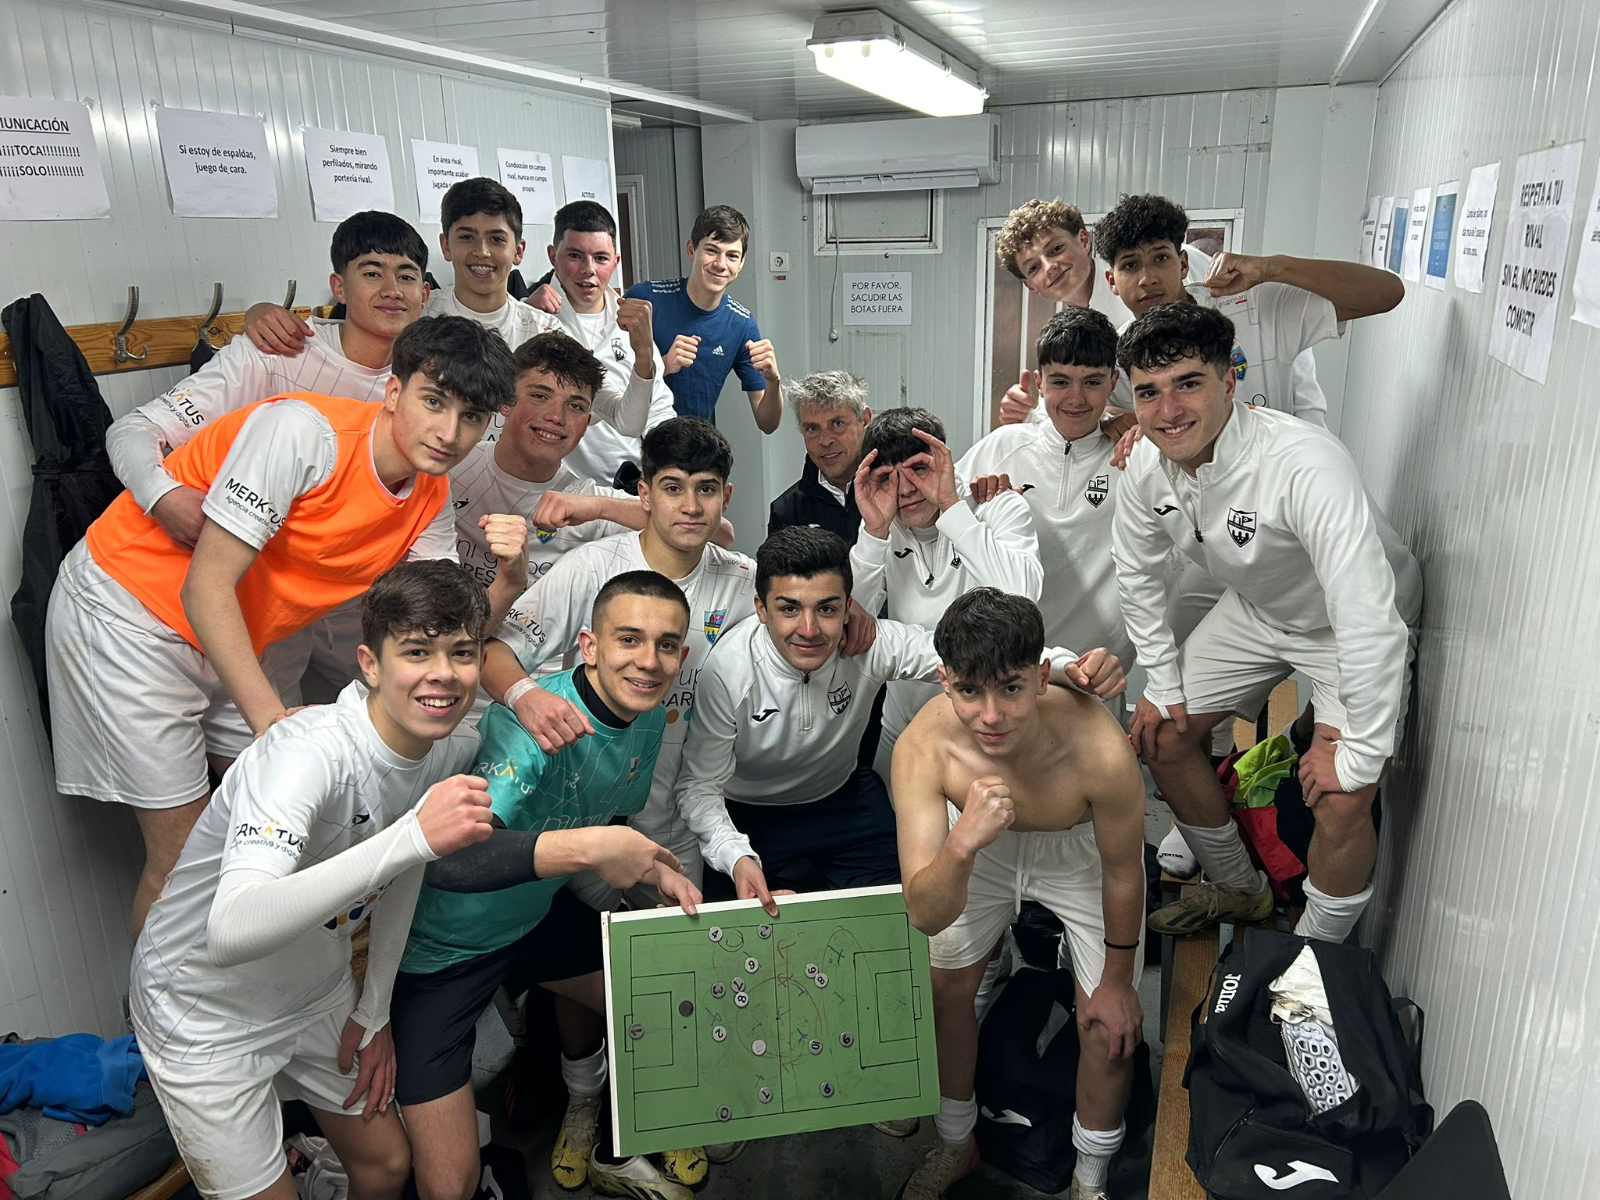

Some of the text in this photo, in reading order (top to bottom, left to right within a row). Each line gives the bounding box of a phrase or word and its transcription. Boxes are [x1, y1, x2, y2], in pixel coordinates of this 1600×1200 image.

[179, 144, 256, 160] Si estoy de espaldas,
[330, 145, 354, 156] Siempre
[195, 162, 247, 174] juego de cara.
[322, 159, 378, 170] perfilados, mirando
[358, 175, 372, 184] rival.
[1520, 182, 1547, 208] RESPETA
[1552, 179, 1564, 206] TU
[1524, 224, 1544, 249] RIVAL
[852, 281, 902, 290] POR FAVOR,
[1501, 263, 1513, 286] SIN
[1520, 266, 1532, 292] NO
[1531, 269, 1557, 298] PUEDES
[851, 293, 903, 302] SACUDIR LAS
[850, 305, 904, 313] BOTAS FUERA
[1505, 304, 1536, 337] COMPETIR
[225, 495, 249, 513] Agencia
[506, 608, 546, 643] RKATUS
[711, 929, 719, 939] 4
